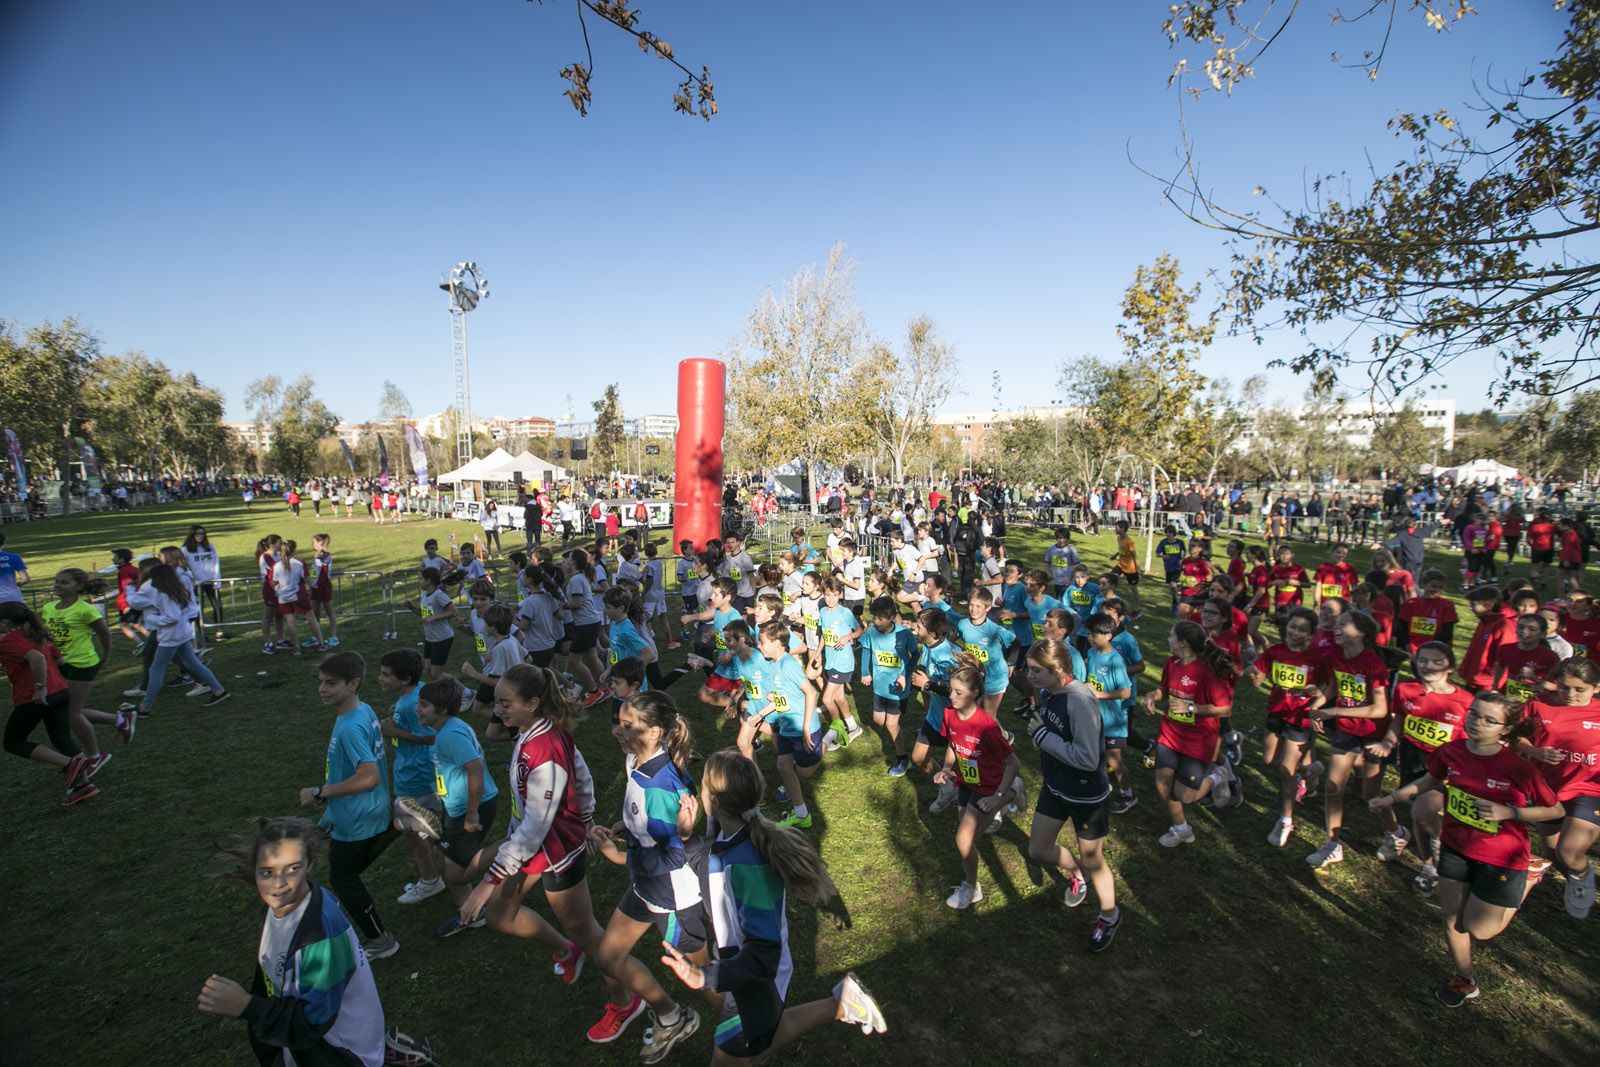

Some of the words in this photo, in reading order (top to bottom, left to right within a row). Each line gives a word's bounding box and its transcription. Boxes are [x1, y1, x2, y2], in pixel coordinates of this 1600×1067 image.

[878, 654, 900, 663] 2877
[1047, 708, 1064, 732] YORK
[1407, 719, 1448, 742] 0652
[1566, 751, 1598, 766] ISME
[1450, 795, 1486, 821] 063
